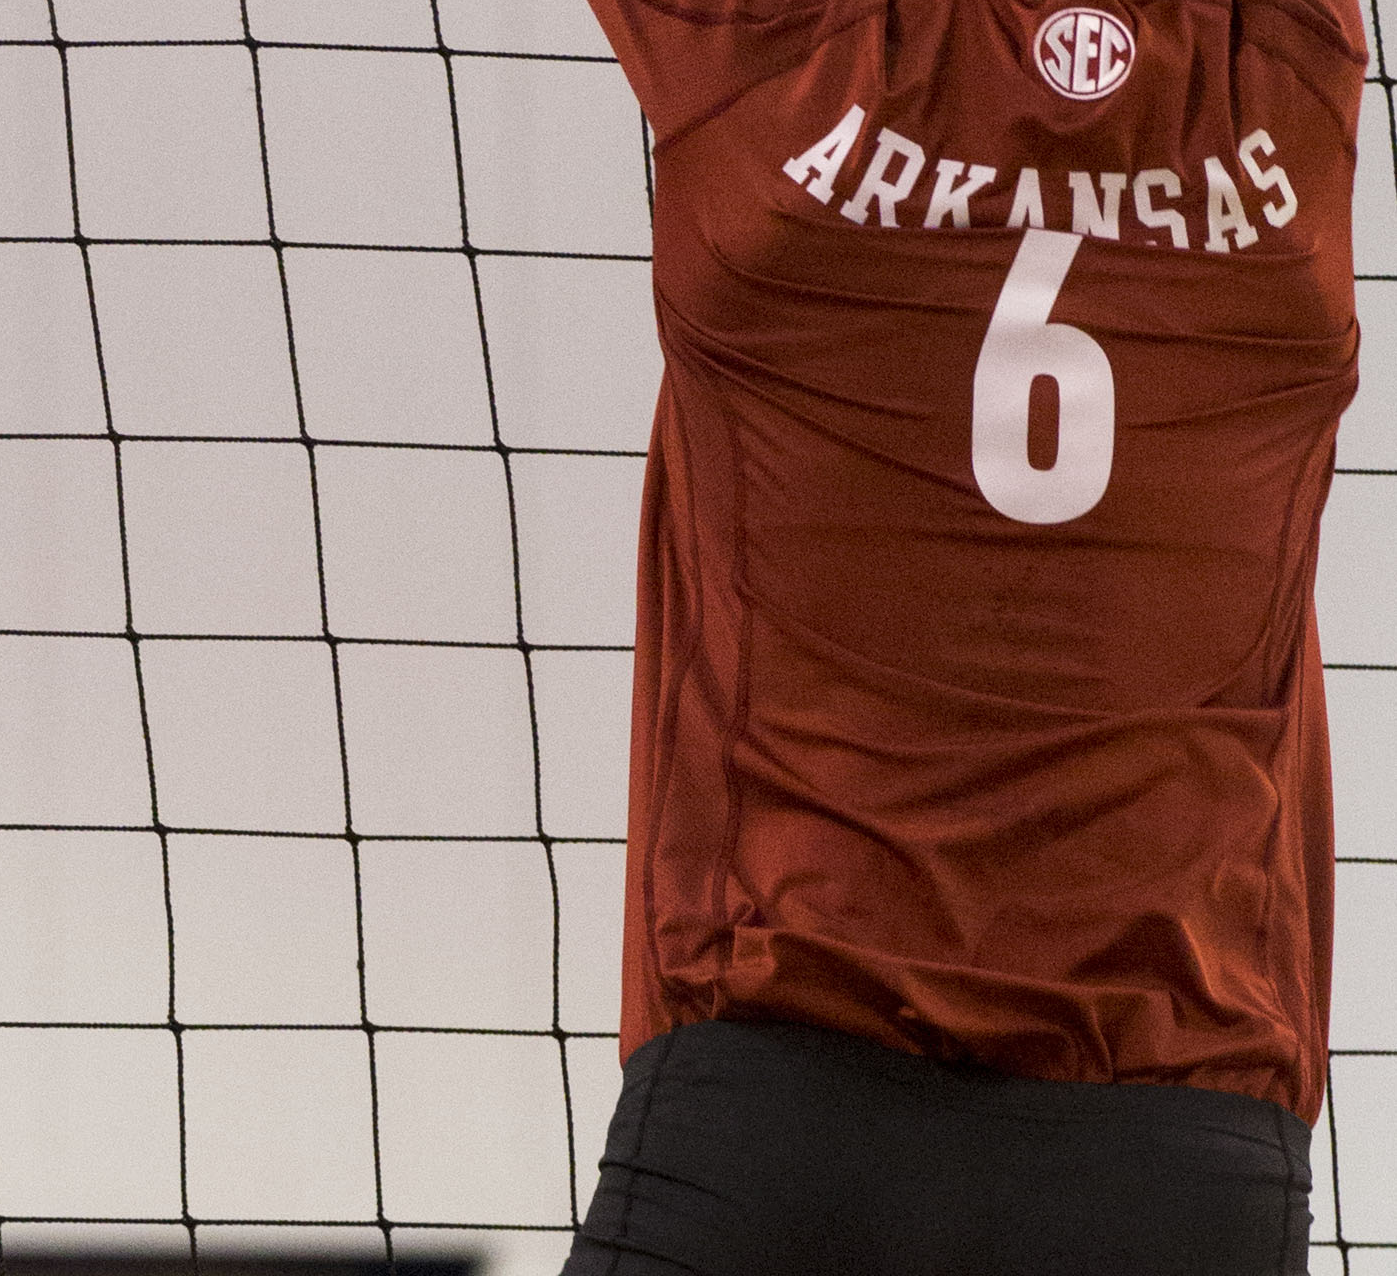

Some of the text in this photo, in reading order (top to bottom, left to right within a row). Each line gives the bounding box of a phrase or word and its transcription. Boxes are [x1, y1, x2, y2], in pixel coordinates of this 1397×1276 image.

[1044, 13, 1128, 94] SEC
[782, 103, 1299, 254] ARKANSAS
[971, 227, 1116, 525] 6
